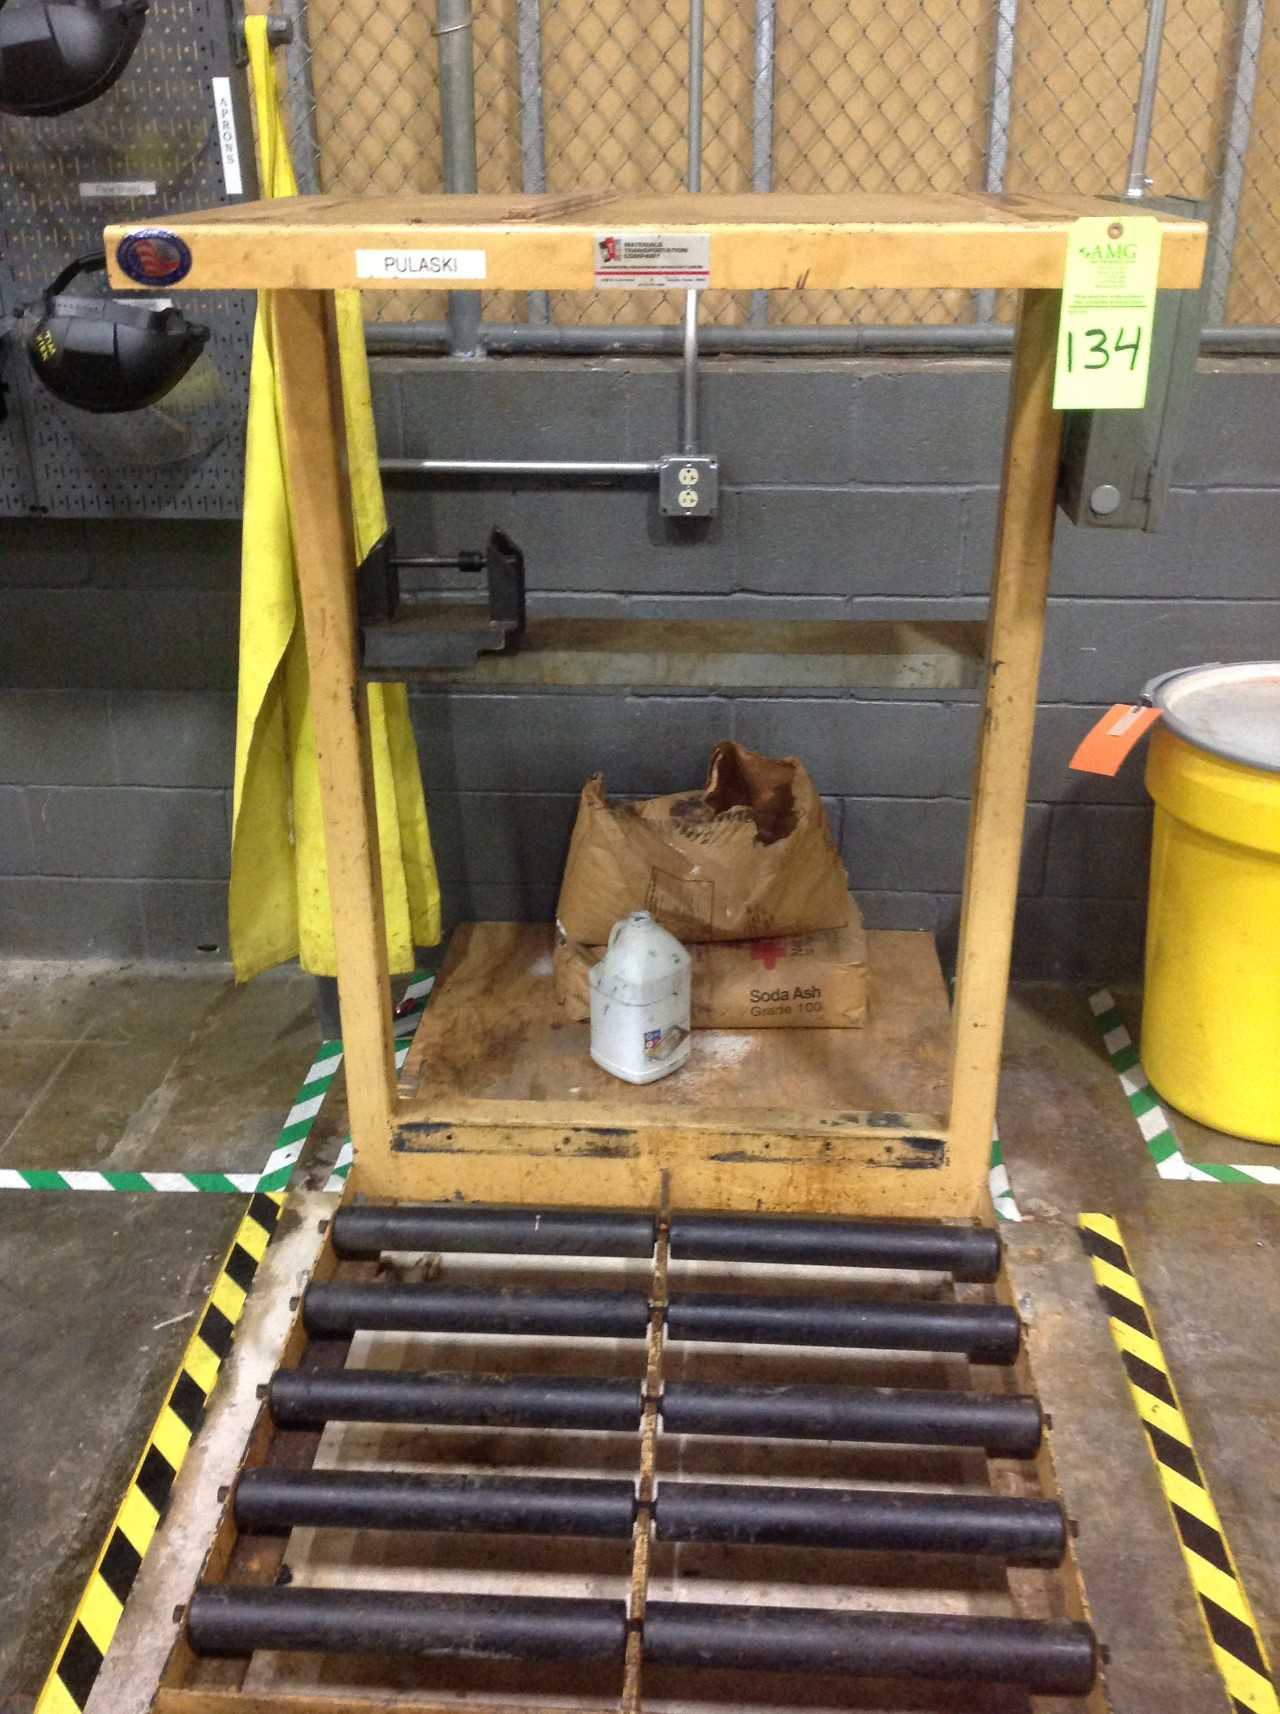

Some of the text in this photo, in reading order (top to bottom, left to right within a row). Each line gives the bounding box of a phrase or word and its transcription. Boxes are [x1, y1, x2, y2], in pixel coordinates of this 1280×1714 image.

[219, 97, 235, 165] APRONS
[1092, 243, 1137, 259] AMG
[384, 256, 458, 273] PULASKI
[1067, 326, 1141, 373] 134
[750, 985, 822, 1003] Soda Ash
[750, 1004, 793, 1017] Grade
